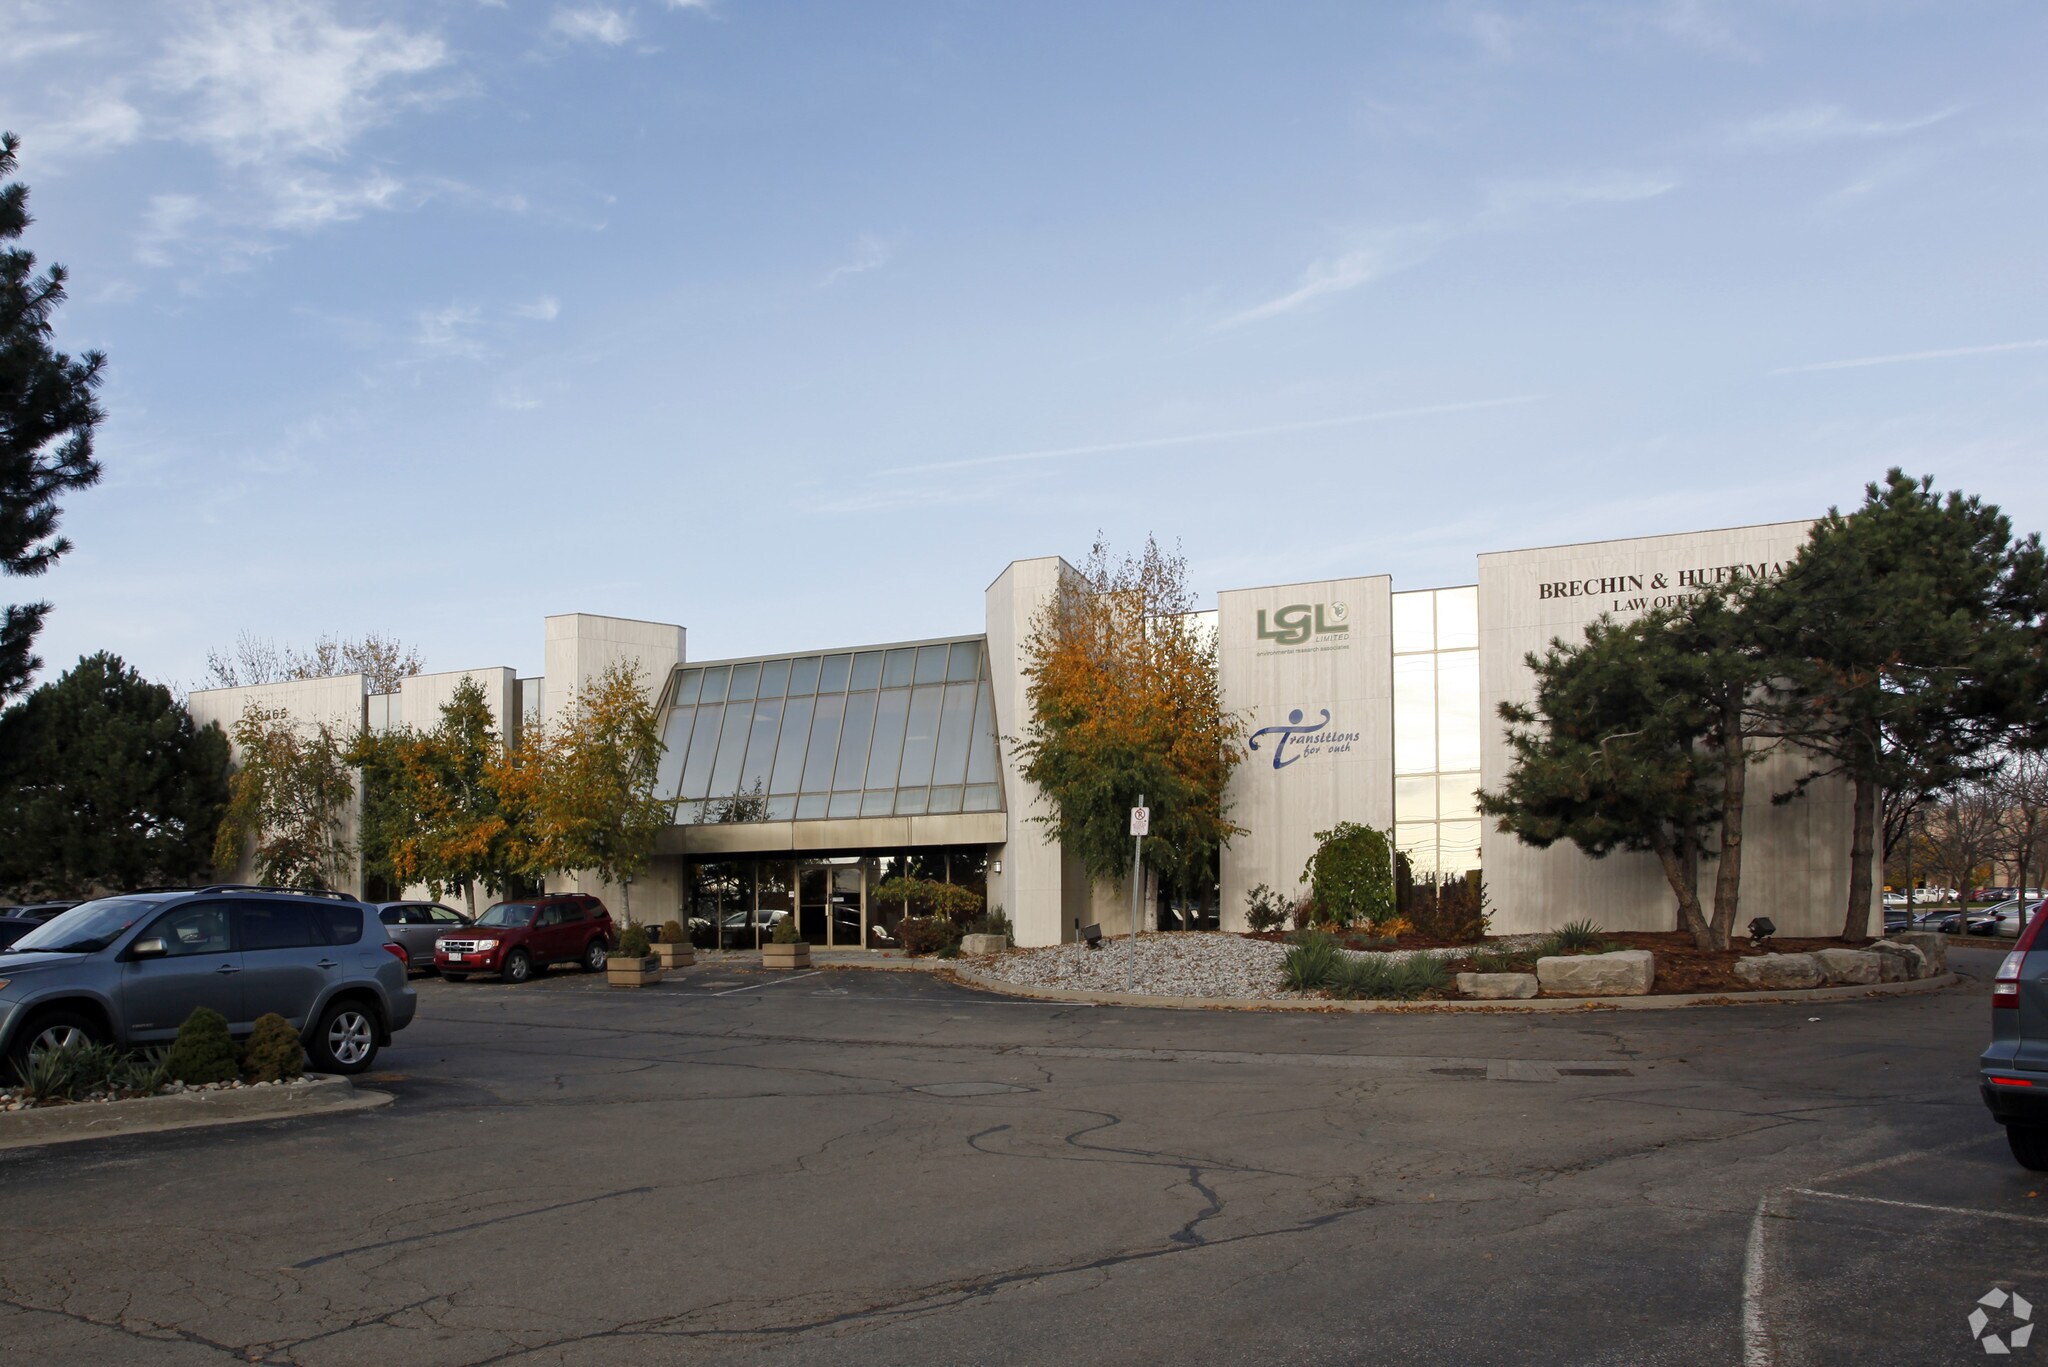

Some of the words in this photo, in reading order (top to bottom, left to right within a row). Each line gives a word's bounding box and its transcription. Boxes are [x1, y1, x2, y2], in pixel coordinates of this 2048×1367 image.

[1539, 574, 1644, 600] BRECHIN
[1650, 572, 1669, 590] &
[1678, 560, 1799, 588] HUFFMA
[1613, 597, 1649, 612] LAW
[1257, 603, 1349, 646] LGL
[1315, 633, 1350, 643] LIMITED
[1256, 648, 1295, 657] environmental
[1295, 646, 1319, 655] research
[1320, 644, 1350, 652] associates
[1249, 708, 1360, 769] Transitions
[1303, 744, 1320, 758] for
